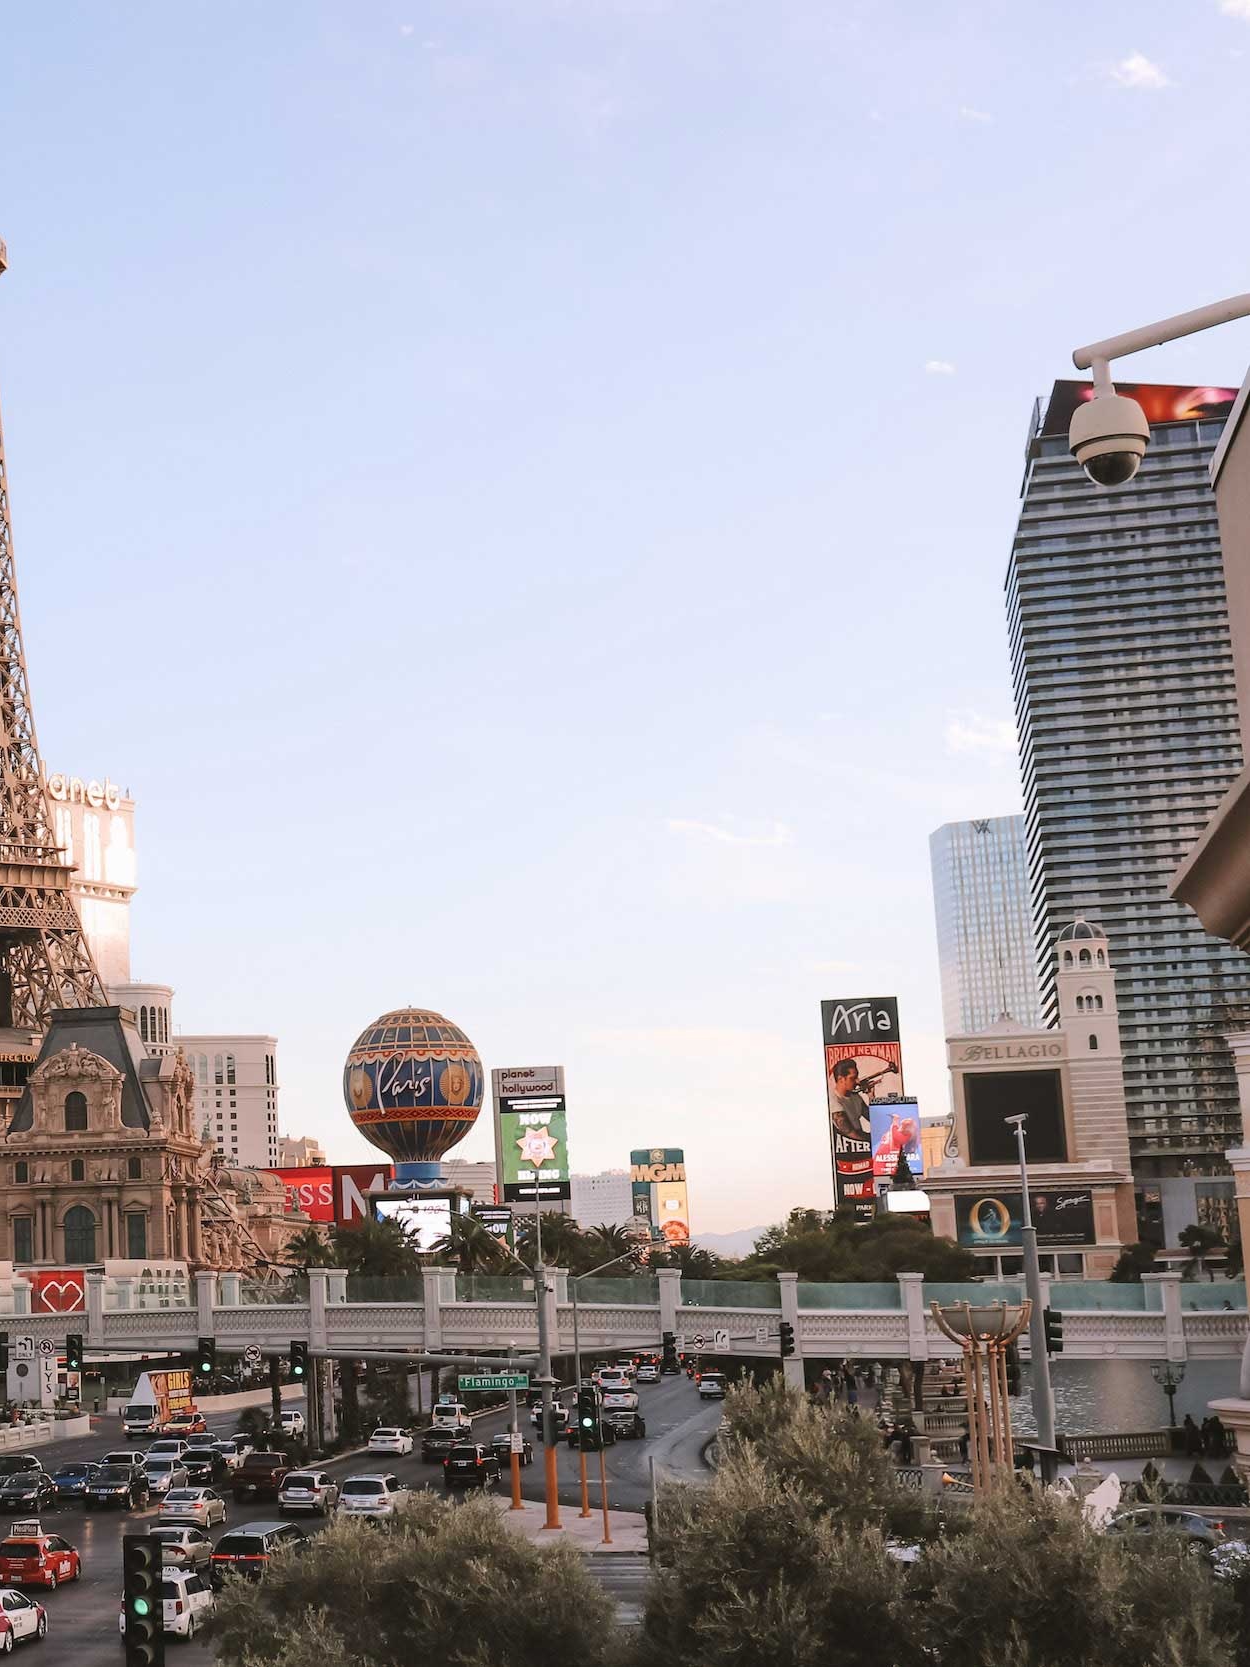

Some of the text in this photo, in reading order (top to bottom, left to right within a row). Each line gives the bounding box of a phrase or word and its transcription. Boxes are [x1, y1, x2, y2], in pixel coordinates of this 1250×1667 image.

[831, 1003, 892, 1036] Aria
[828, 1045, 898, 1067] BRIAN NEWMAN
[959, 1044, 1062, 1062] BELLAGIO
[377, 1051, 430, 1115] Paris
[502, 1069, 535, 1081] planet
[502, 1083, 554, 1094] hollywood
[519, 1113, 552, 1125] NOW
[836, 1133, 871, 1153] AFTER
[630, 1163, 686, 1182] MGM
[844, 1183, 864, 1196] NOW
[168, 1372, 190, 1390] GIRLS
[465, 1377, 515, 1388] Flamingo
